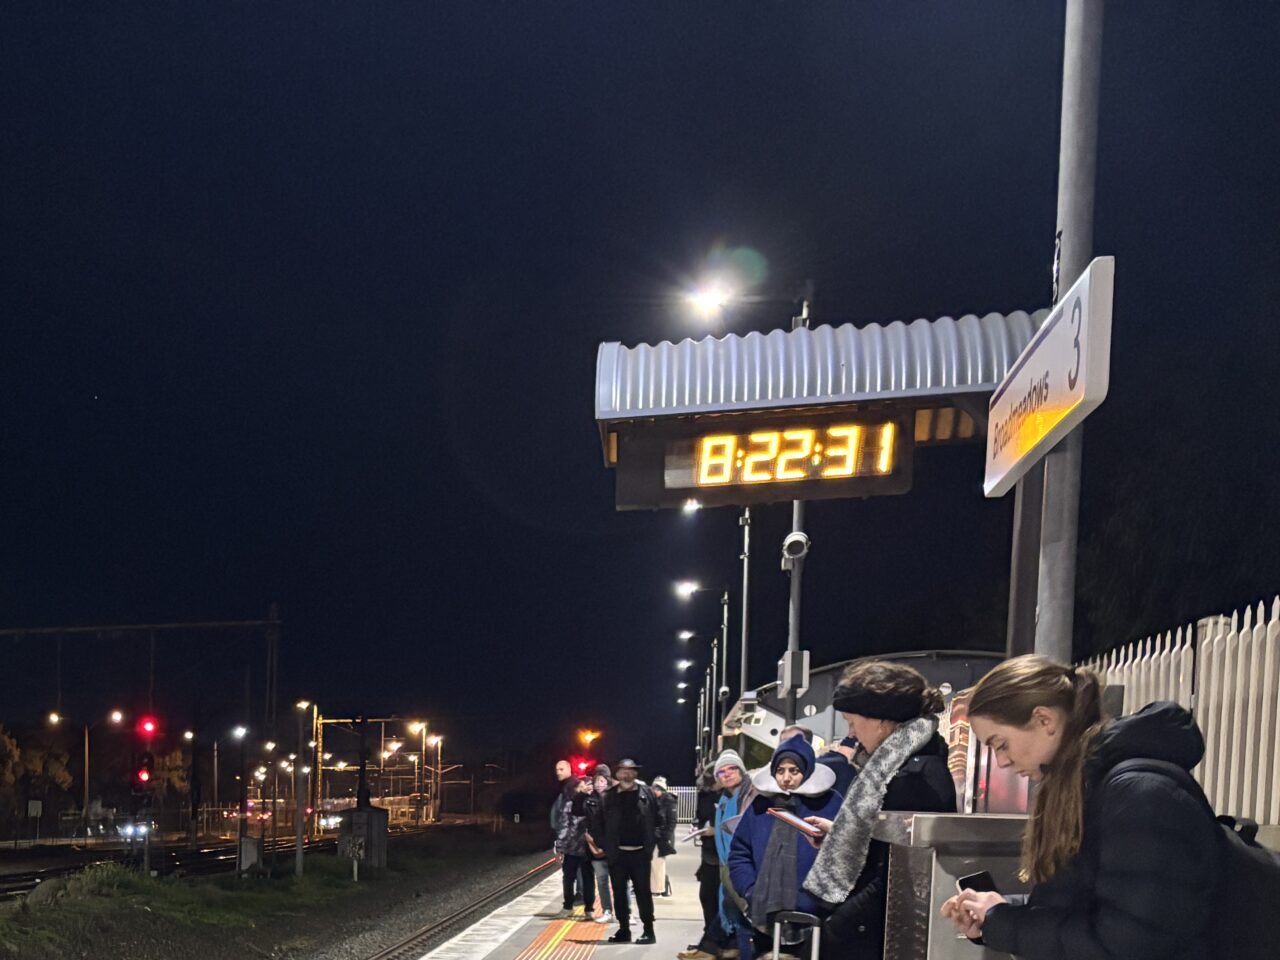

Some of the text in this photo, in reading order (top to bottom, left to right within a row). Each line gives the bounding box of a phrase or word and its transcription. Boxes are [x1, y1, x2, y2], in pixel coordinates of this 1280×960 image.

[1068, 296, 1083, 391] 3
[697, 421, 896, 487] 8:22:31
[992, 370, 1050, 460] Broadmeadows
